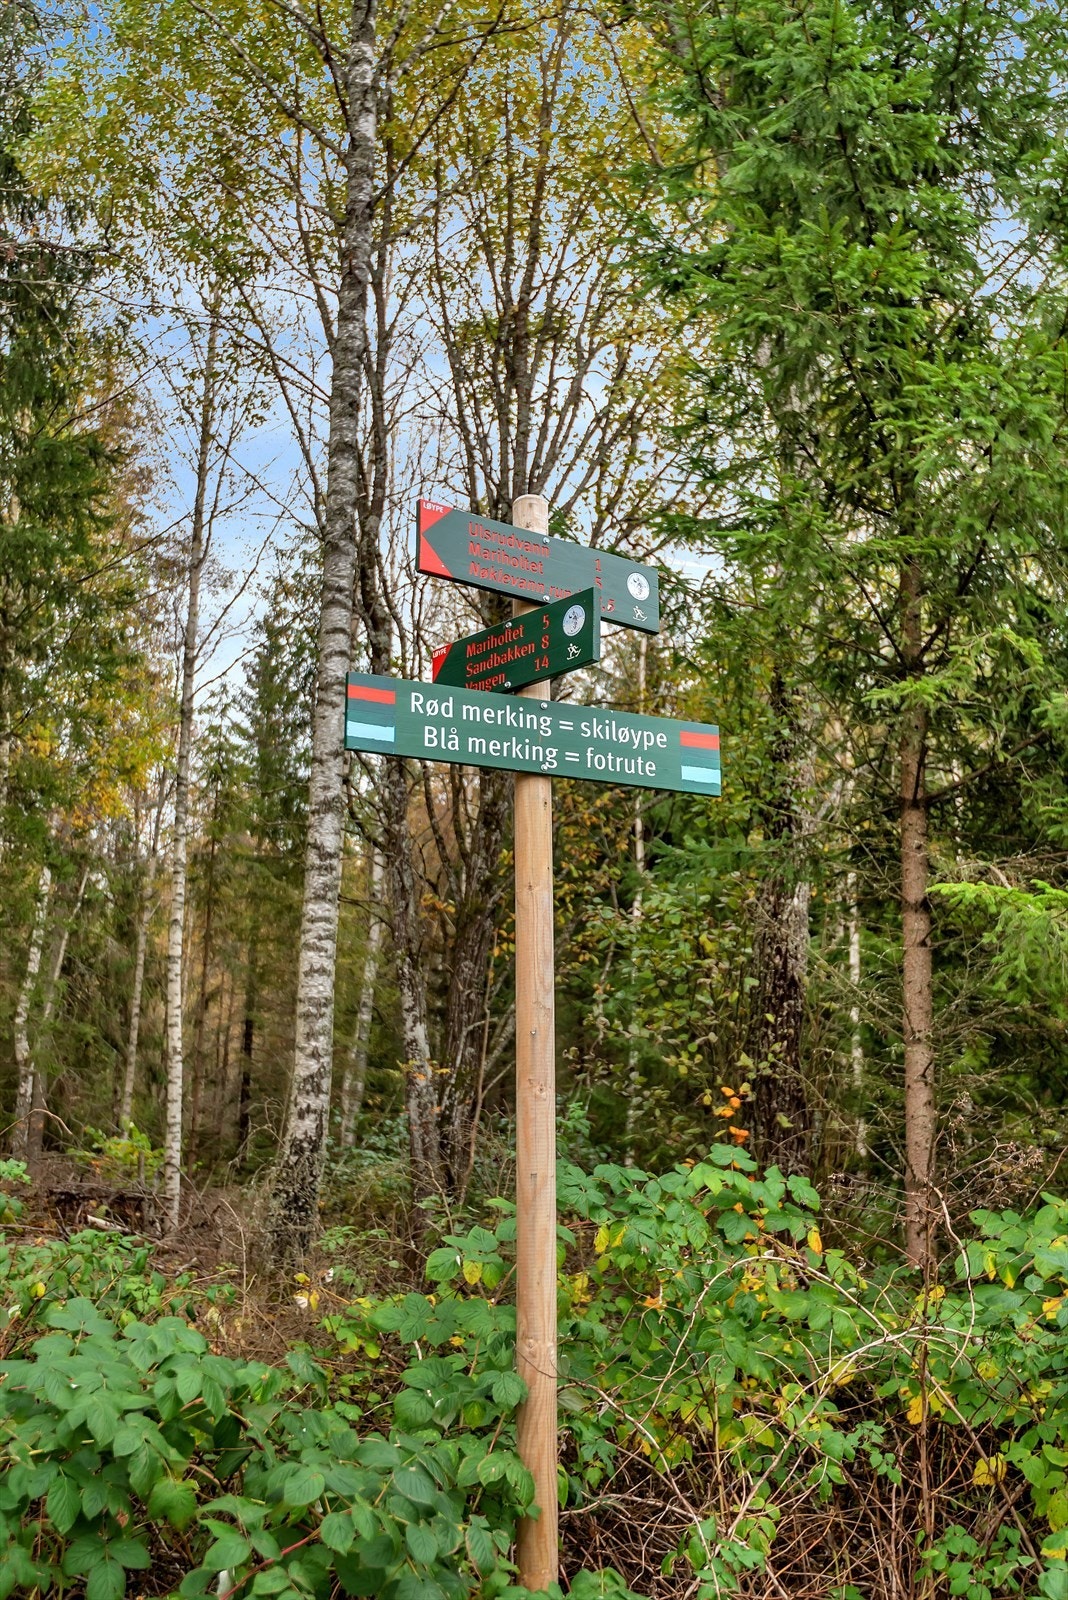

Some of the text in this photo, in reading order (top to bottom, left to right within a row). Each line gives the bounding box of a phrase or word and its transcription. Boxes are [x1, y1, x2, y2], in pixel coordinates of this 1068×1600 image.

[423, 502, 444, 514] LØYPE
[468, 521, 602, 572] Ulsrudvann 1
[468, 541, 544, 574] Mariholtet
[469, 560, 545, 595] Nøklevann
[432, 647, 446, 658] LØYPE
[466, 613, 550, 658] Mariholtet 5
[466, 634, 550, 678] Sandbakken 8
[534, 655, 550, 672] 14
[410, 692, 668, 751] Rød merking = skiløype
[424, 726, 656, 776] Blå merking = fotrute
